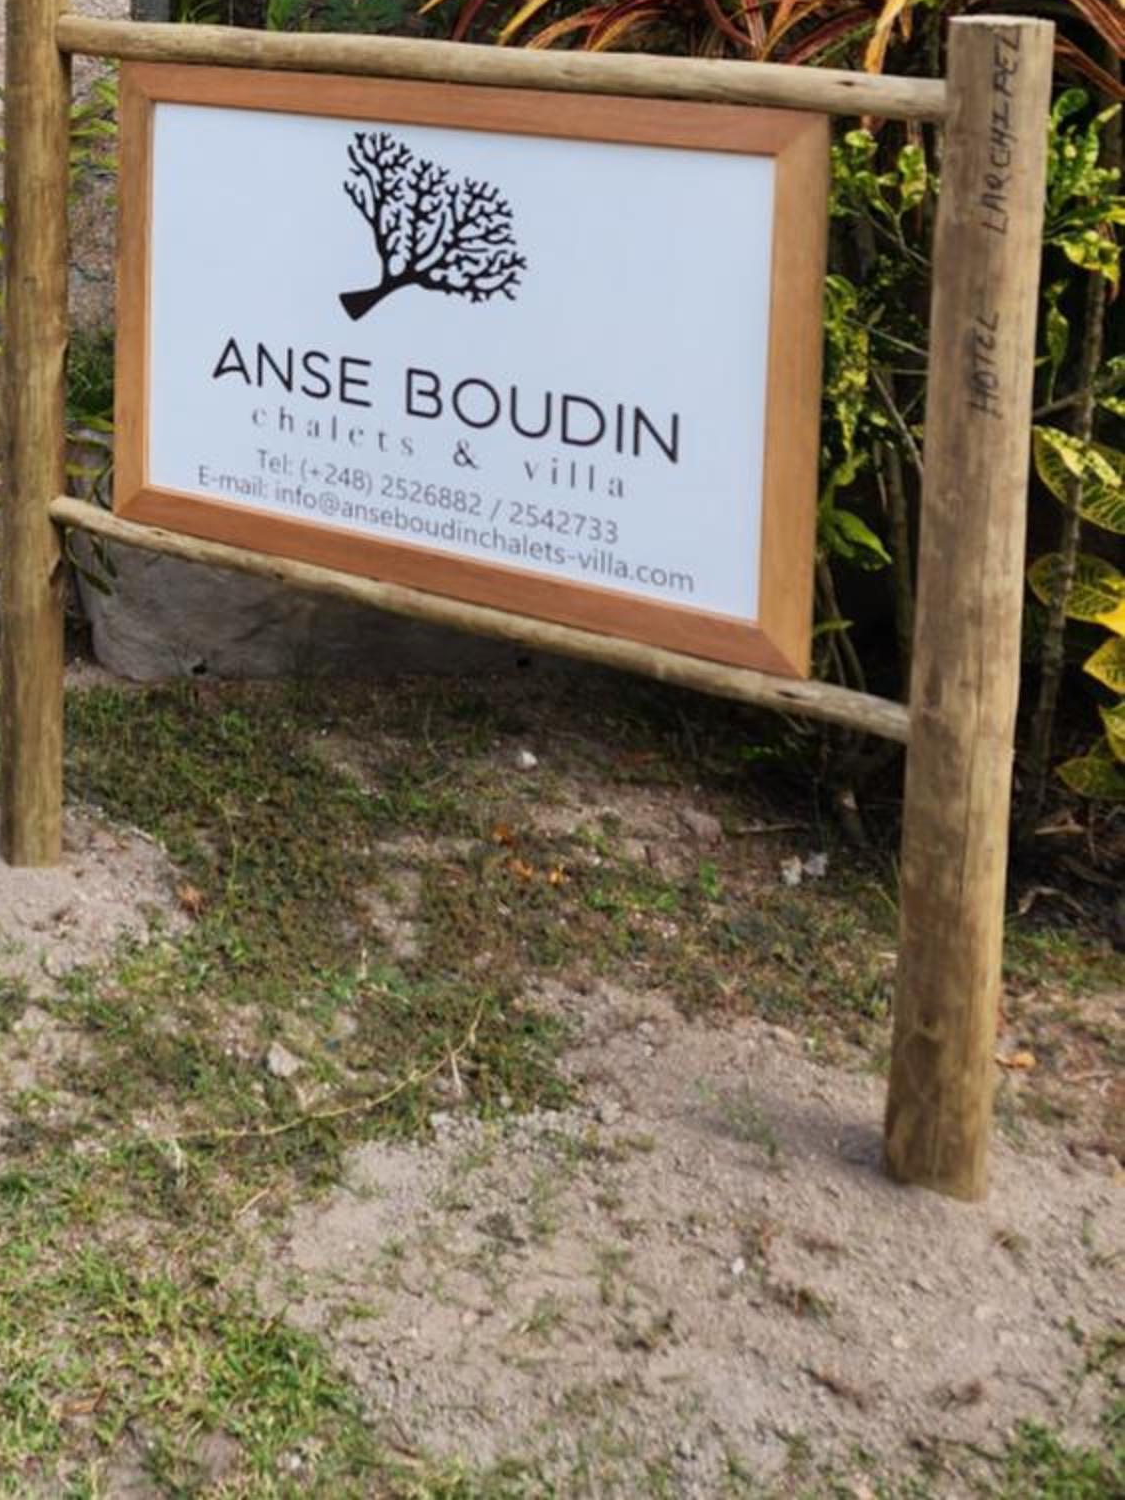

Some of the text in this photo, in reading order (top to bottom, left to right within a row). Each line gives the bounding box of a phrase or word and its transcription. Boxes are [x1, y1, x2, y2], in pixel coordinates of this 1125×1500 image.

[212, 337, 681, 464] ANSE BOUDIN
[971, 309, 1003, 420] HOTEL
[251, 406, 625, 499] chalets & villa
[257, 448, 619, 545] Tel: (+248) 2526882 / 2542733
[198, 464, 695, 593] E-mail: info@anseboudinchalets-villa.com
